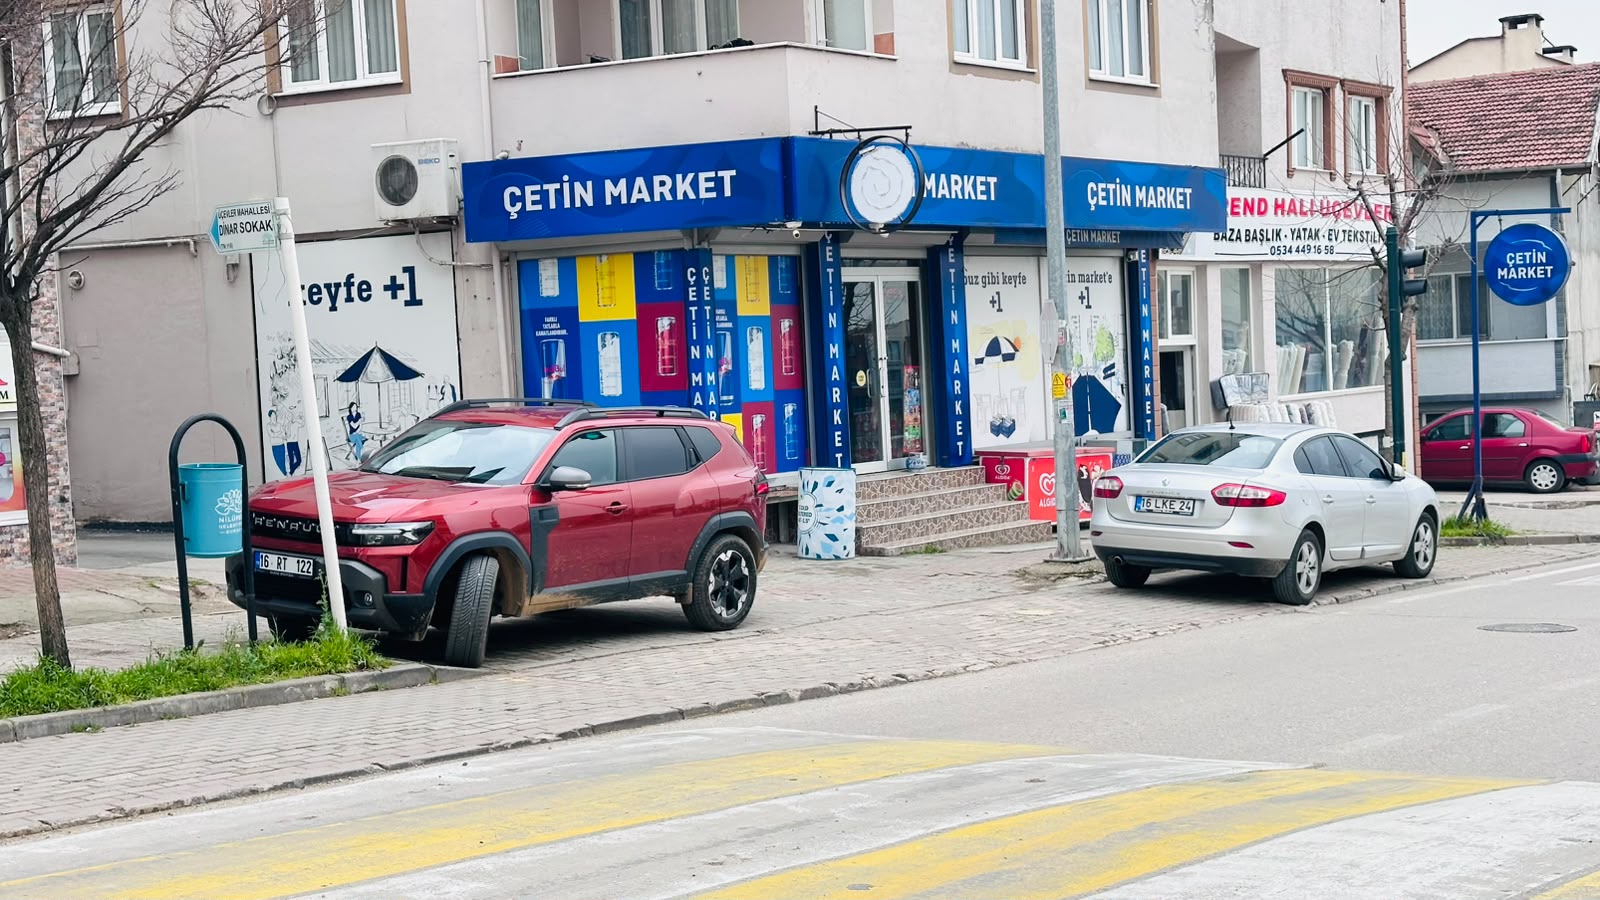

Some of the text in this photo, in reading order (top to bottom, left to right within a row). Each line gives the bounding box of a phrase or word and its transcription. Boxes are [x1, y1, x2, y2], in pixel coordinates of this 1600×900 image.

[503, 169, 737, 219] ÇETİN MARKET
[923, 173, 997, 201] MARKET
[1087, 178, 1192, 210] ÇETİN MARKET
[237, 203, 271, 216] MAHALLESİ
[1226, 197, 1269, 217] END
[1274, 198, 1314, 217] HALI
[219, 219, 273, 236] DİNAR SOKAK
[1090, 230, 1120, 243] MARKET
[1213, 228, 1242, 242] BAZA
[1244, 228, 1282, 246] BAŞLIK
[1290, 227, 1320, 241] YATAK
[1328, 228, 1340, 241] EV
[1270, 244, 1335, 255] 0534 449 16 58
[1497, 249, 1553, 280] ÇETİN MARKET
[383, 265, 424, 307] +1
[981, 271, 1000, 288] gibi
[1001, 271, 1027, 288] keyfe
[989, 291, 1003, 312] +1
[1078, 286, 1092, 309] +1
[687, 267, 701, 359] ÇETİN
[702, 266, 714, 359] ÇETİN
[1140, 249, 1152, 432] ETİN MARKET
[829, 343, 843, 468] MARKET
[951, 338, 963, 457] MARKET
[1039, 497, 1056, 508] ALGID
[1142, 498, 1191, 511] 16 LKE 24
[260, 553, 312, 574] 16 RT 122
